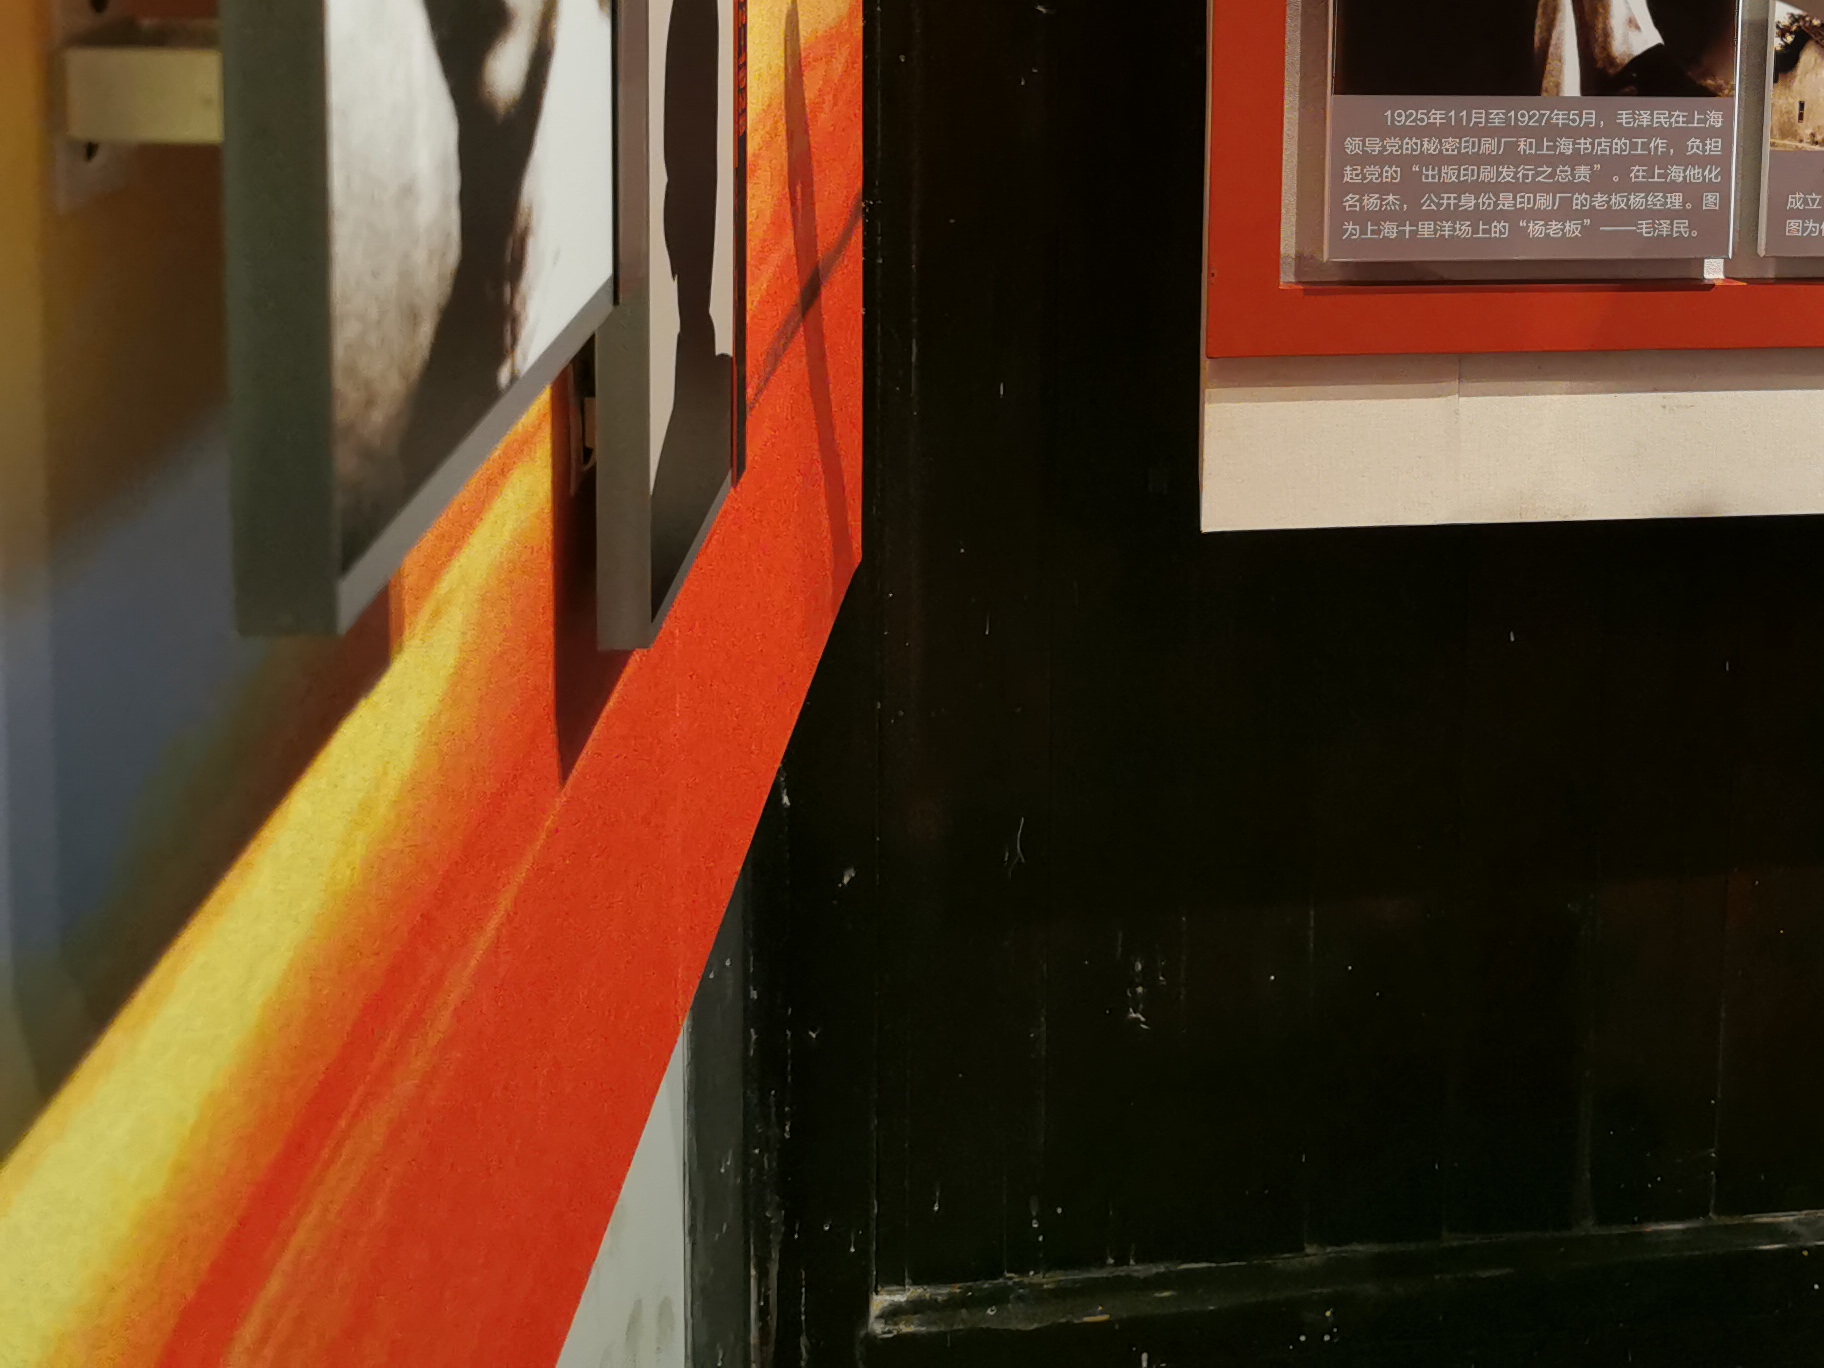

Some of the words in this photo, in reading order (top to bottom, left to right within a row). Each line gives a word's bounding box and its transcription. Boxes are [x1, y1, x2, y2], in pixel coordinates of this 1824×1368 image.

[1383, 109, 1724, 129] 1925年11月至1927年5月，毛泽民在上海
[1343, 136, 1723, 156] 领导党的秘密印刷厂和上海书店的工作，负担
[1341, 191, 1720, 212] 名杨杰，公开身份是印刷厂的老板杨经理。图
